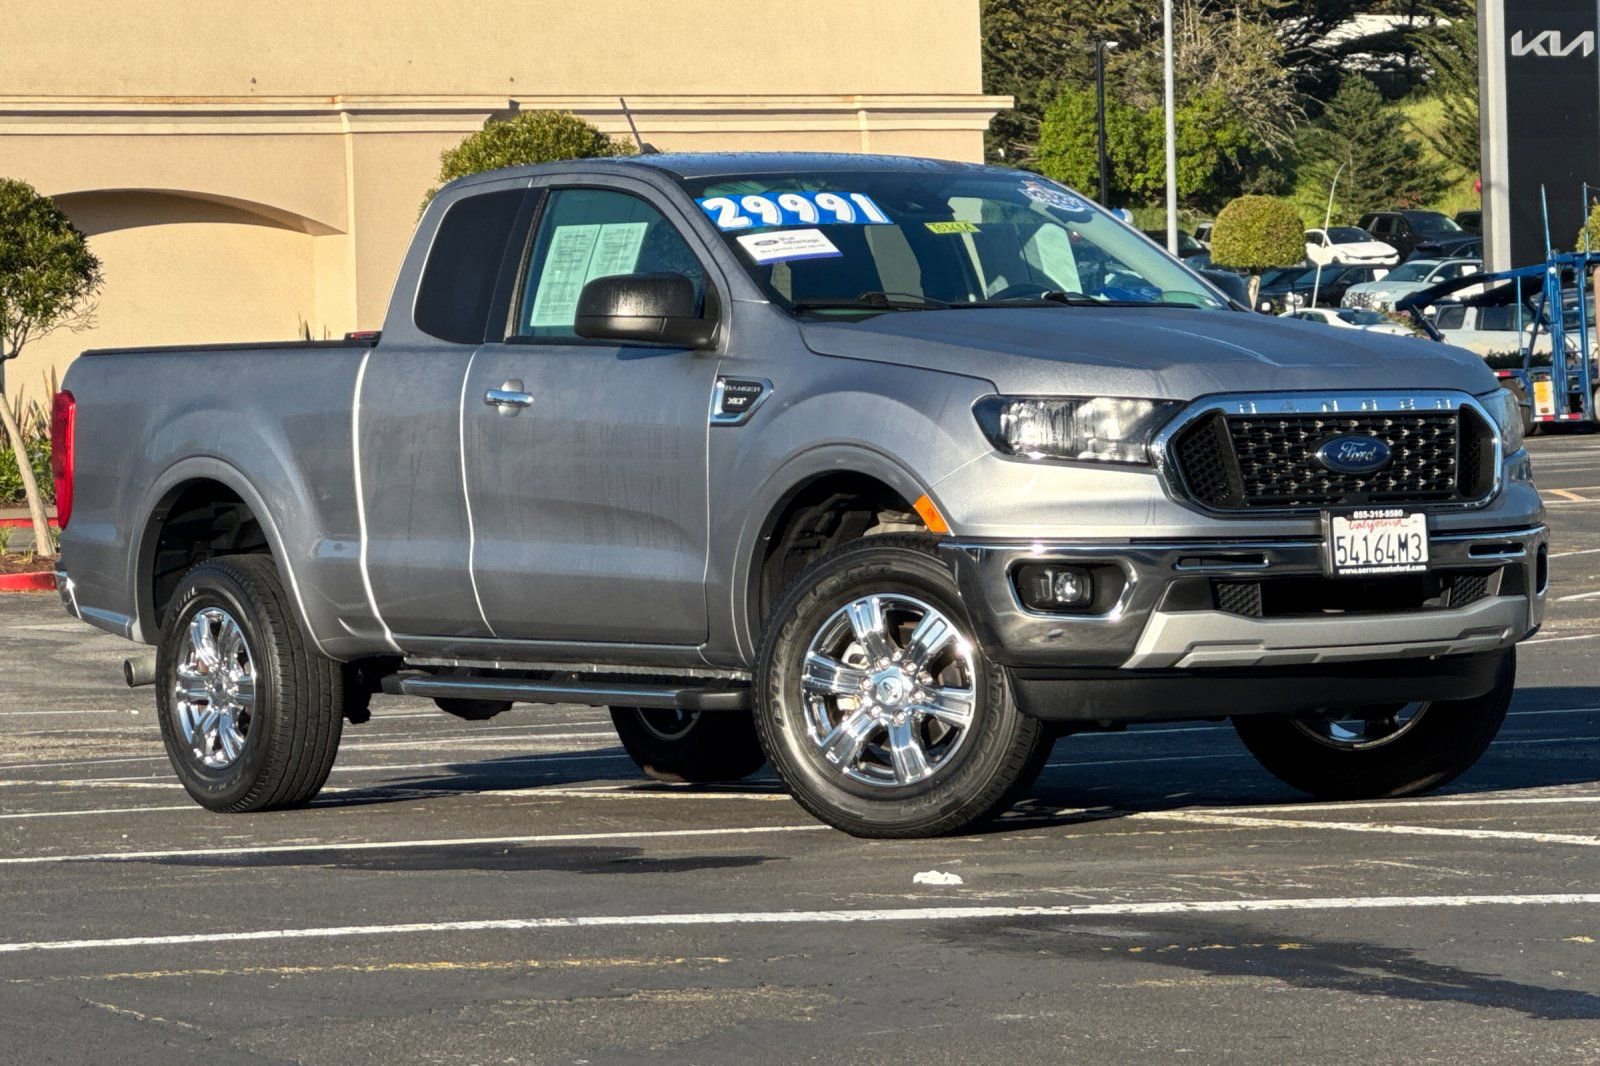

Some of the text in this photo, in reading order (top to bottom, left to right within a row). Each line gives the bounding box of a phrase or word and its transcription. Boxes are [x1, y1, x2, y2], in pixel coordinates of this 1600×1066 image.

[1511, 30, 1595, 57] KIA
[701, 193, 890, 229] 29991
[1337, 441, 1377, 463] Ford
[1346, 518, 1409, 533] California
[1336, 532, 1422, 565] 54164M3
